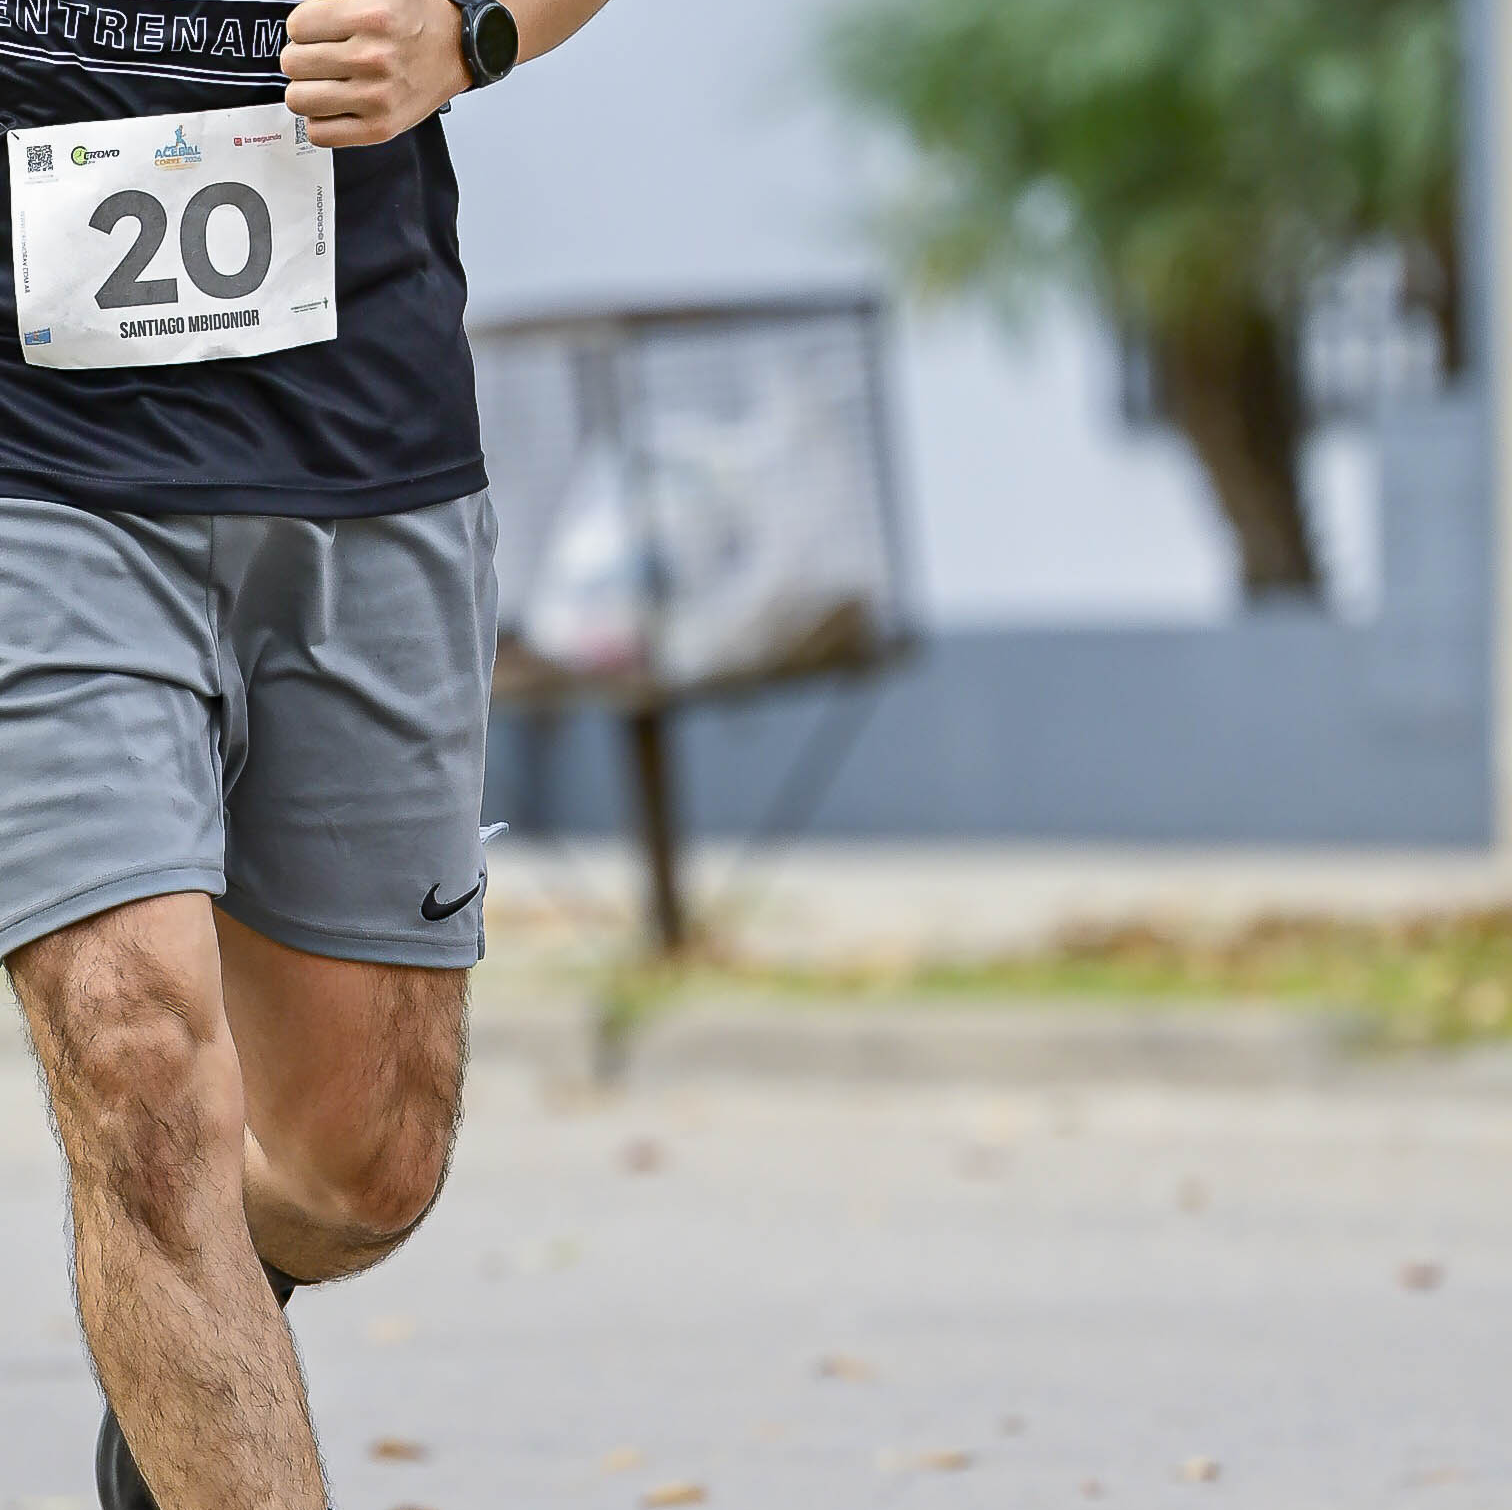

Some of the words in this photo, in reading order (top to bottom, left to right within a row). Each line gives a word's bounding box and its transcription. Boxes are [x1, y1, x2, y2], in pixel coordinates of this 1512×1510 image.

[88, 181, 273, 310] 20
[119, 316, 185, 339] SANTIAGO
[188, 308, 260, 333] MBIDONIOR
